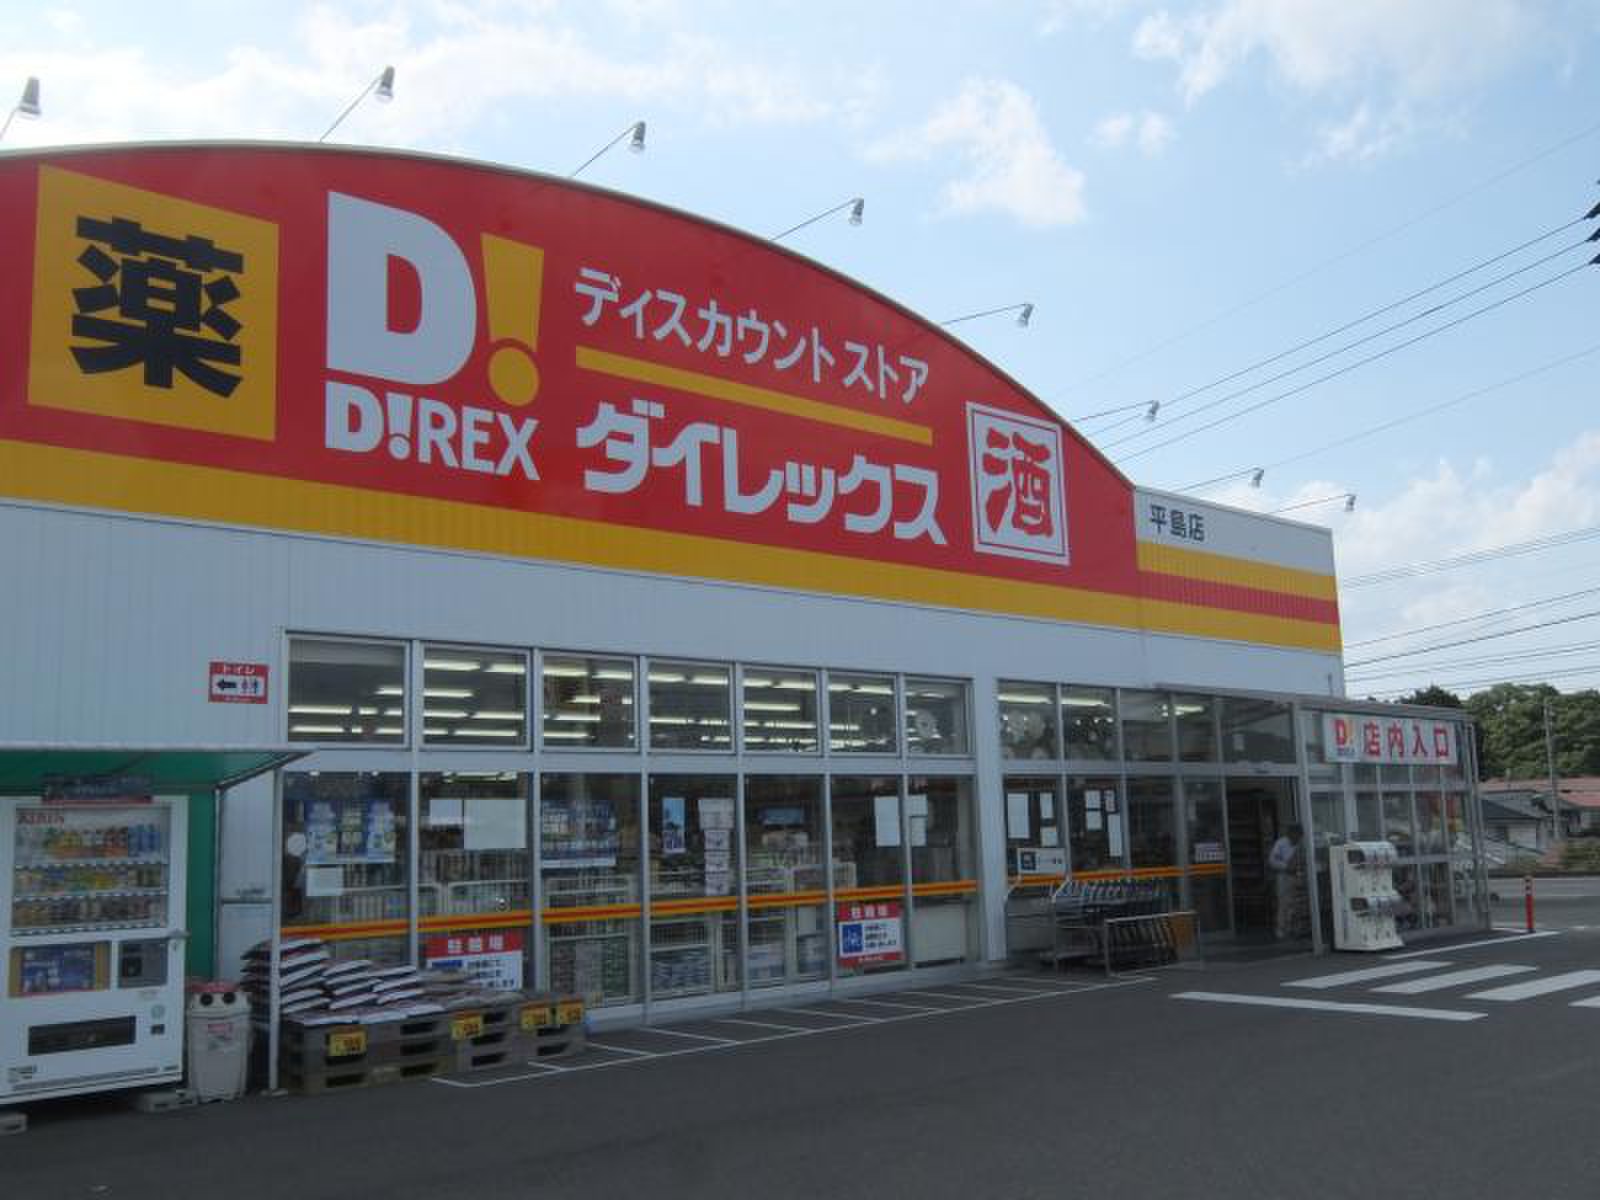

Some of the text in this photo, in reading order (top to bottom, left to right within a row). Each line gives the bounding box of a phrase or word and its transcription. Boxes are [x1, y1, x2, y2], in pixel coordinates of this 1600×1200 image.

[70, 214, 244, 398] 薬
[575, 398, 947, 546] ダイレックス
[980, 425, 1056, 540] 酒
[1149, 503, 1206, 542] 平島店
[1362, 719, 1450, 758] 店内入口
